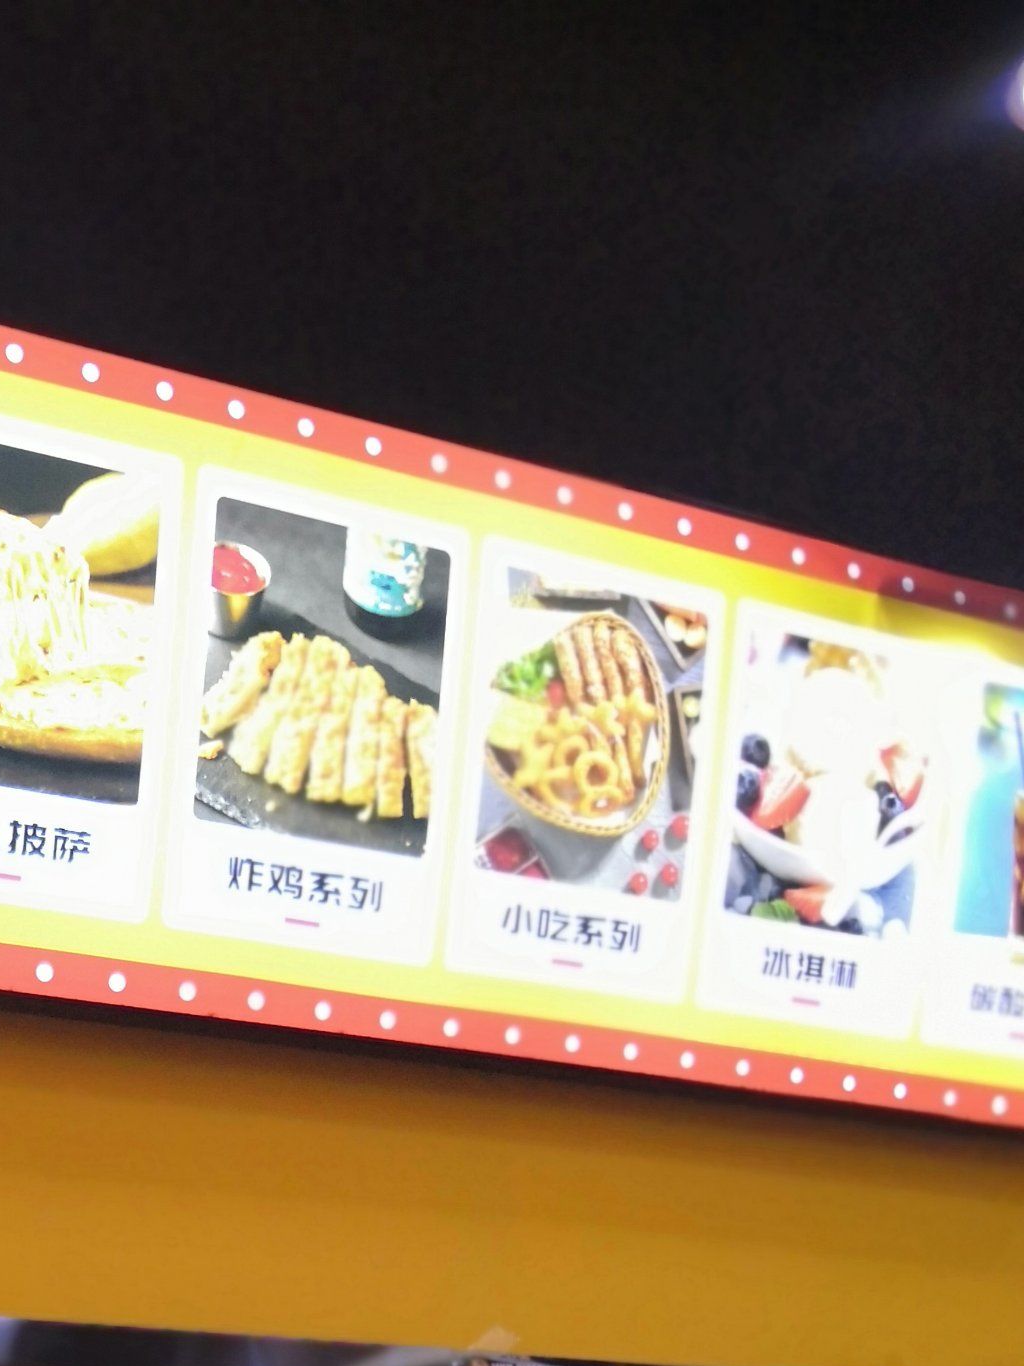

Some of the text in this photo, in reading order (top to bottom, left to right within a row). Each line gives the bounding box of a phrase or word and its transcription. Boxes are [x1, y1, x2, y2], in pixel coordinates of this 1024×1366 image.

[227, 856, 384, 912] 炸鸡系列
[501, 903, 641, 954] 小吃系列
[761, 946, 859, 990] 冰淇淋
